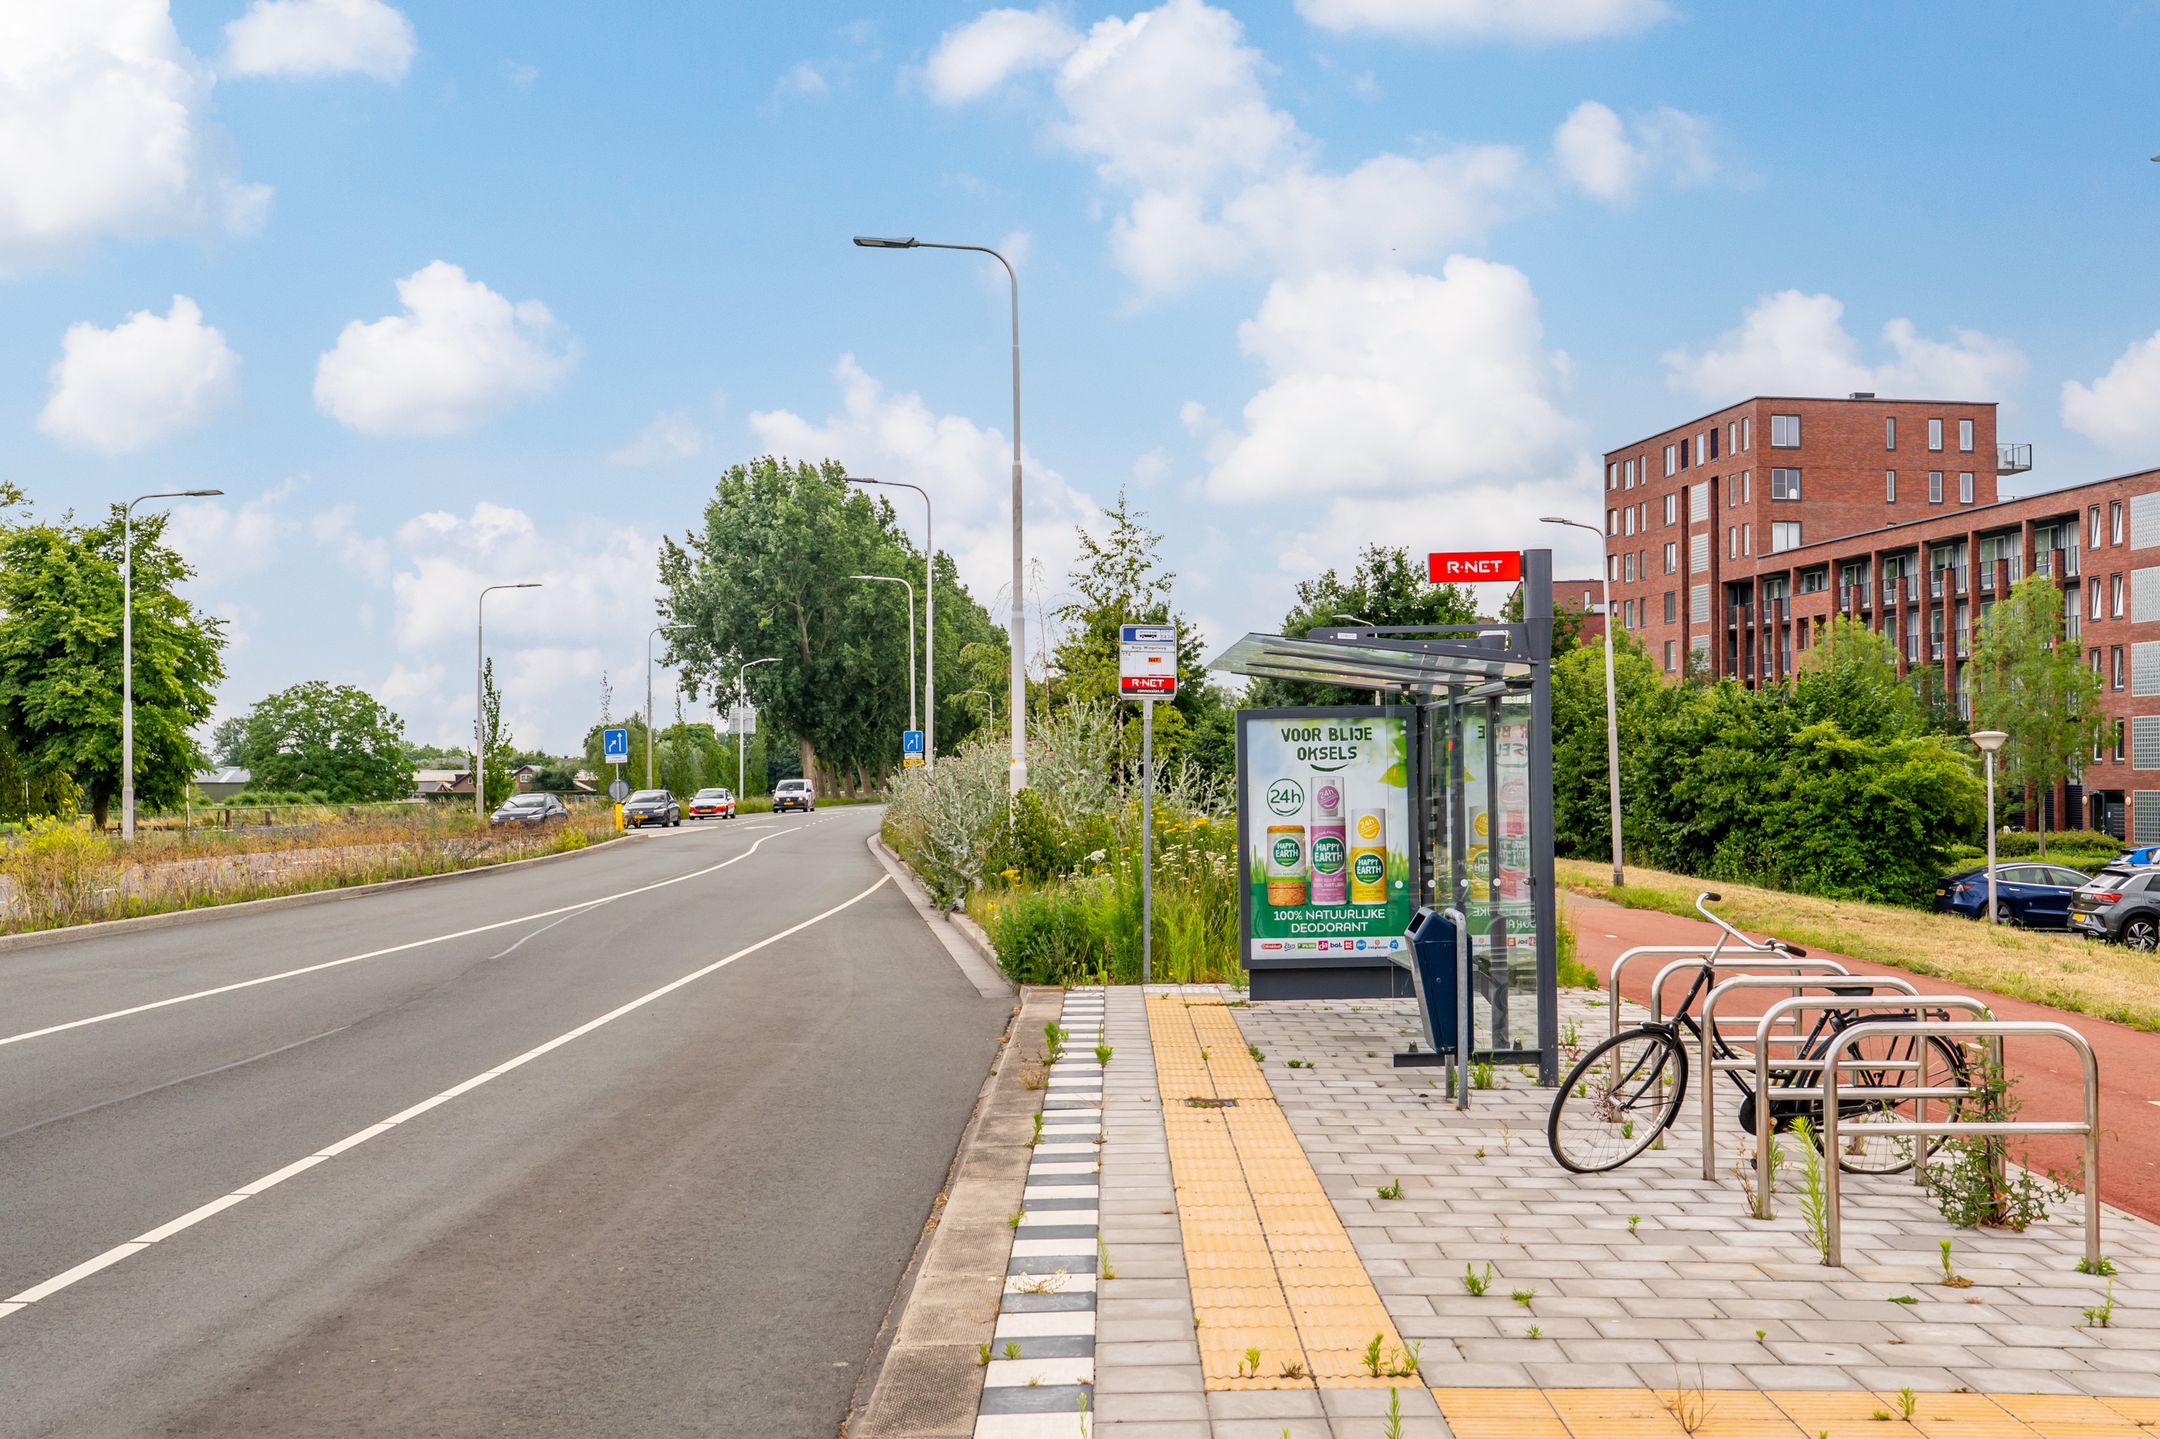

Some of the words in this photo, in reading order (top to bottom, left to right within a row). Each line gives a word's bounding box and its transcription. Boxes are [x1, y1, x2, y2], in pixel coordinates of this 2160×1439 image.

[1281, 727, 1322, 742] VOOR
[1328, 727, 1373, 741] BLIJE
[1296, 746, 1358, 761] OKSELS
[1270, 789, 1301, 804] 24h
[1319, 788, 1334, 798] 24h
[1277, 842, 1296, 850] HAPPY
[1315, 843, 1340, 852] HAPPY
[1275, 849, 1299, 858] EARTH
[1314, 851, 1343, 862] EARTH
[1357, 858, 1378, 866] HAPPY
[1356, 865, 1382, 875] EARTH
[1273, 910, 1303, 921] 100%
[1306, 909, 1386, 920] NATUURLIJKE
[1291, 922, 1368, 933] DEODORANT
